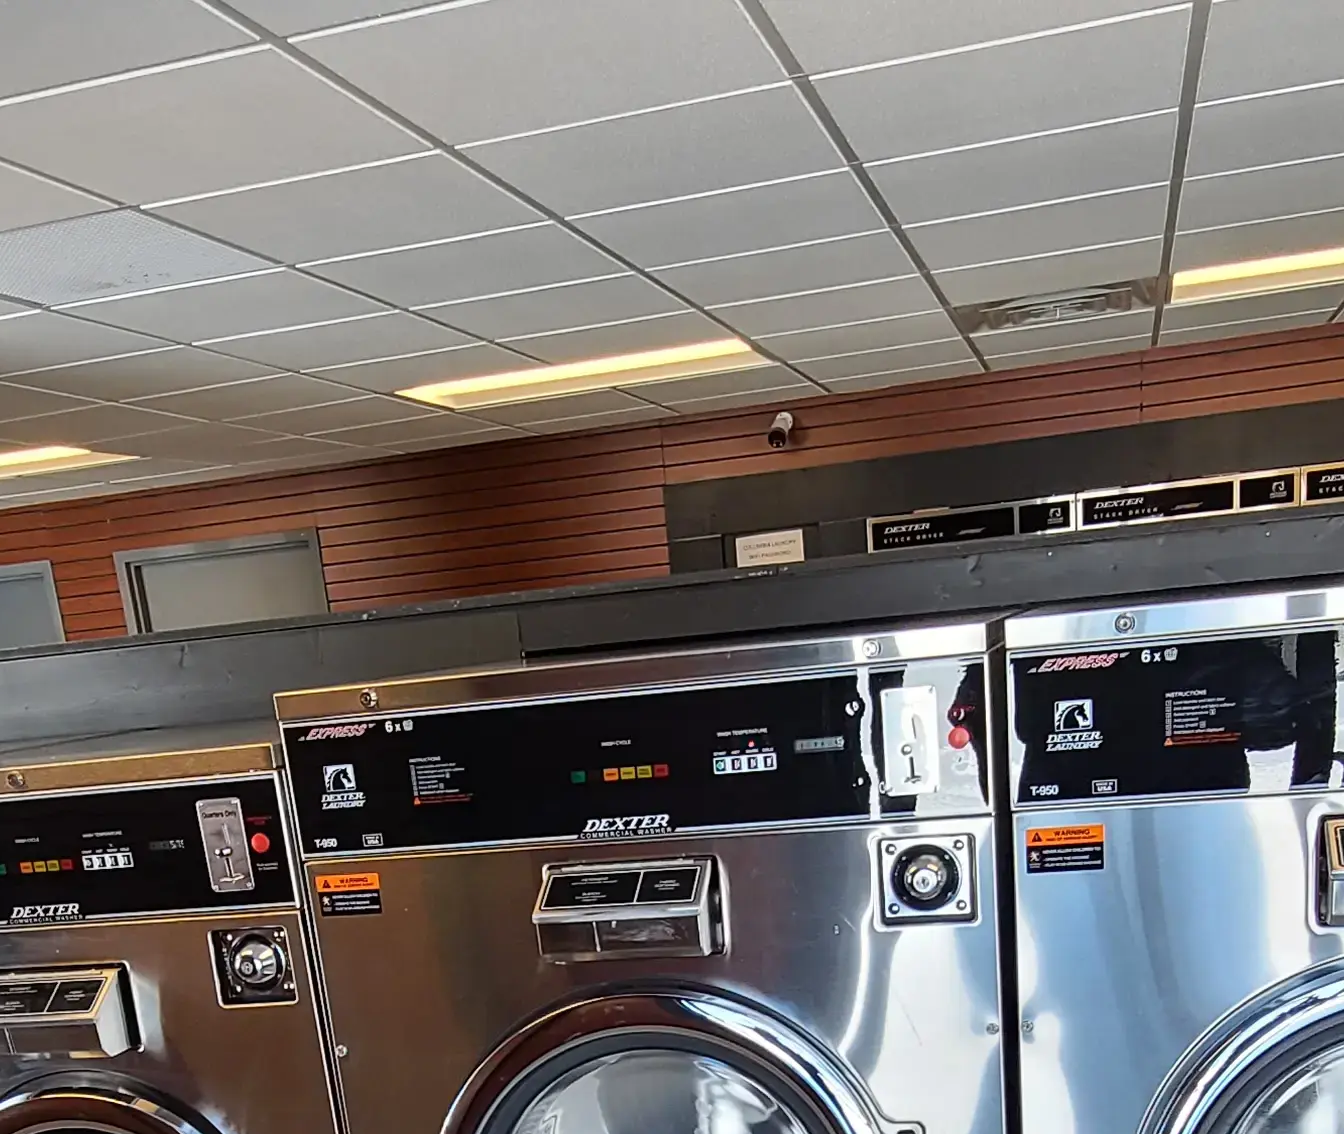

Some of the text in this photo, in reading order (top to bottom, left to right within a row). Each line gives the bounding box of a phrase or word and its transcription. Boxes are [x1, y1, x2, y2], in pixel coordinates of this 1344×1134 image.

[1094, 497, 1144, 509] DEXTER
[884, 523, 930, 534] DEXTER
[1141, 649, 1151, 663] 6
[1038, 653, 1118, 672] EXPRESS
[306, 724, 367, 740] EXPRESS
[385, 721, 393, 733] 6
[1046, 731, 1103, 743] DEXTER
[1046, 740, 1103, 751] LAUNDRY
[1030, 785, 1059, 795] T-950
[321, 792, 365, 802] DEXTER
[202, 811, 223, 819] Quarters
[582, 814, 669, 832] DEXTER
[580, 827, 672, 839] COMMERCIAL WASHER
[11, 903, 79, 918] DEXTER
